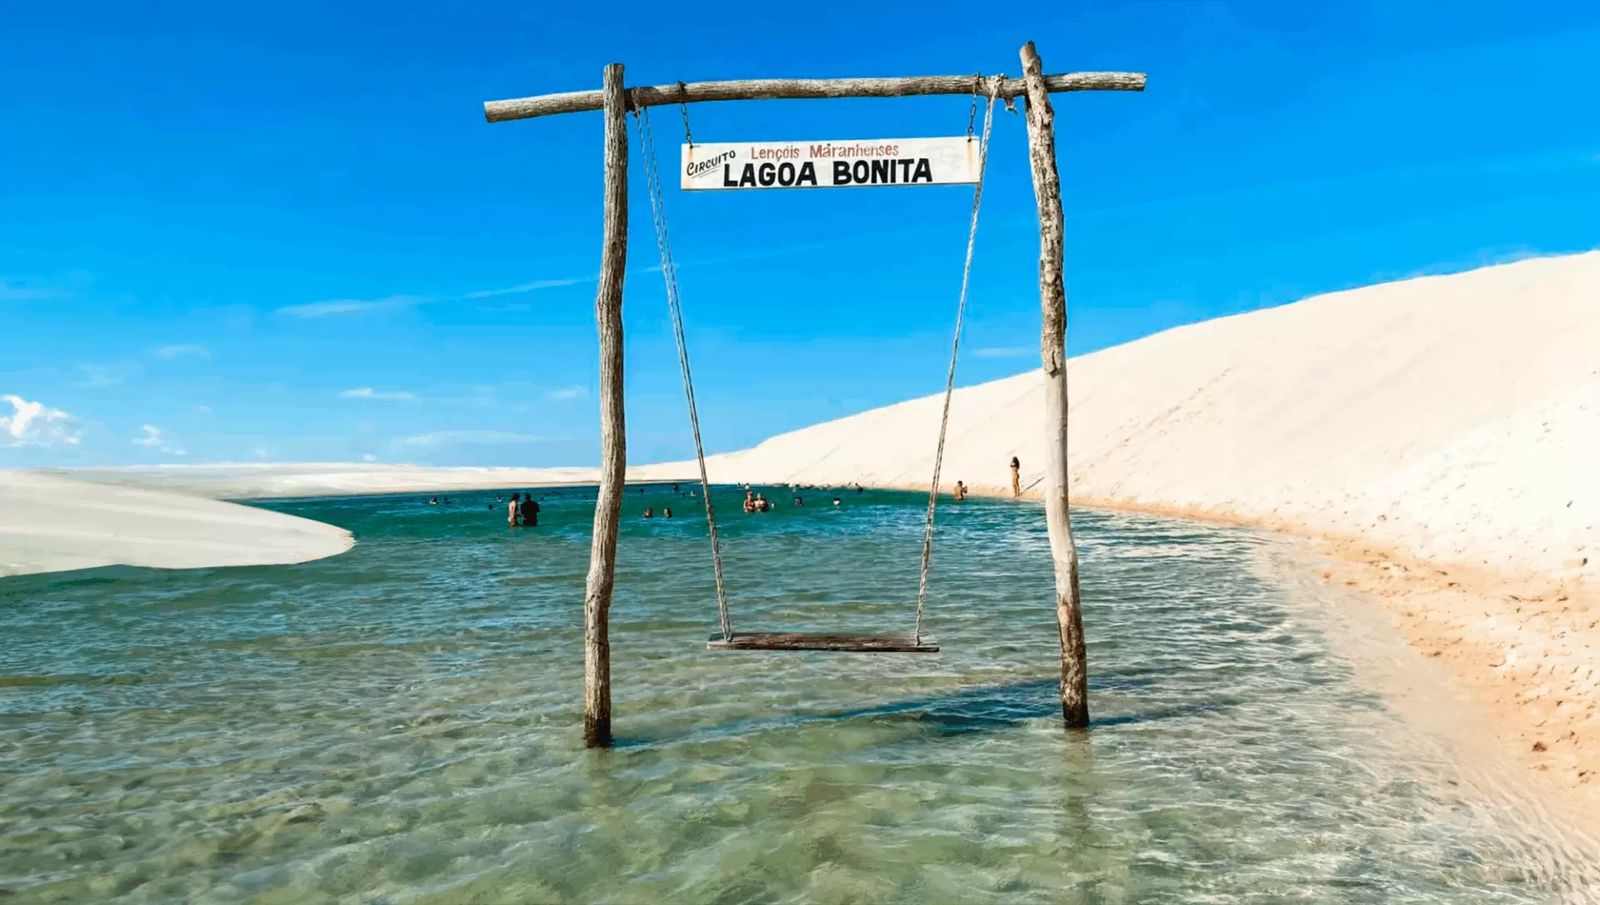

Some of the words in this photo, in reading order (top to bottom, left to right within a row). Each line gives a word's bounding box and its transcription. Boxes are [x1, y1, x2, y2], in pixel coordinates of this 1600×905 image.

[686, 150, 736, 176] CIRCUITO
[723, 161, 818, 187] LAGOA
[833, 158, 933, 185] BONITA
